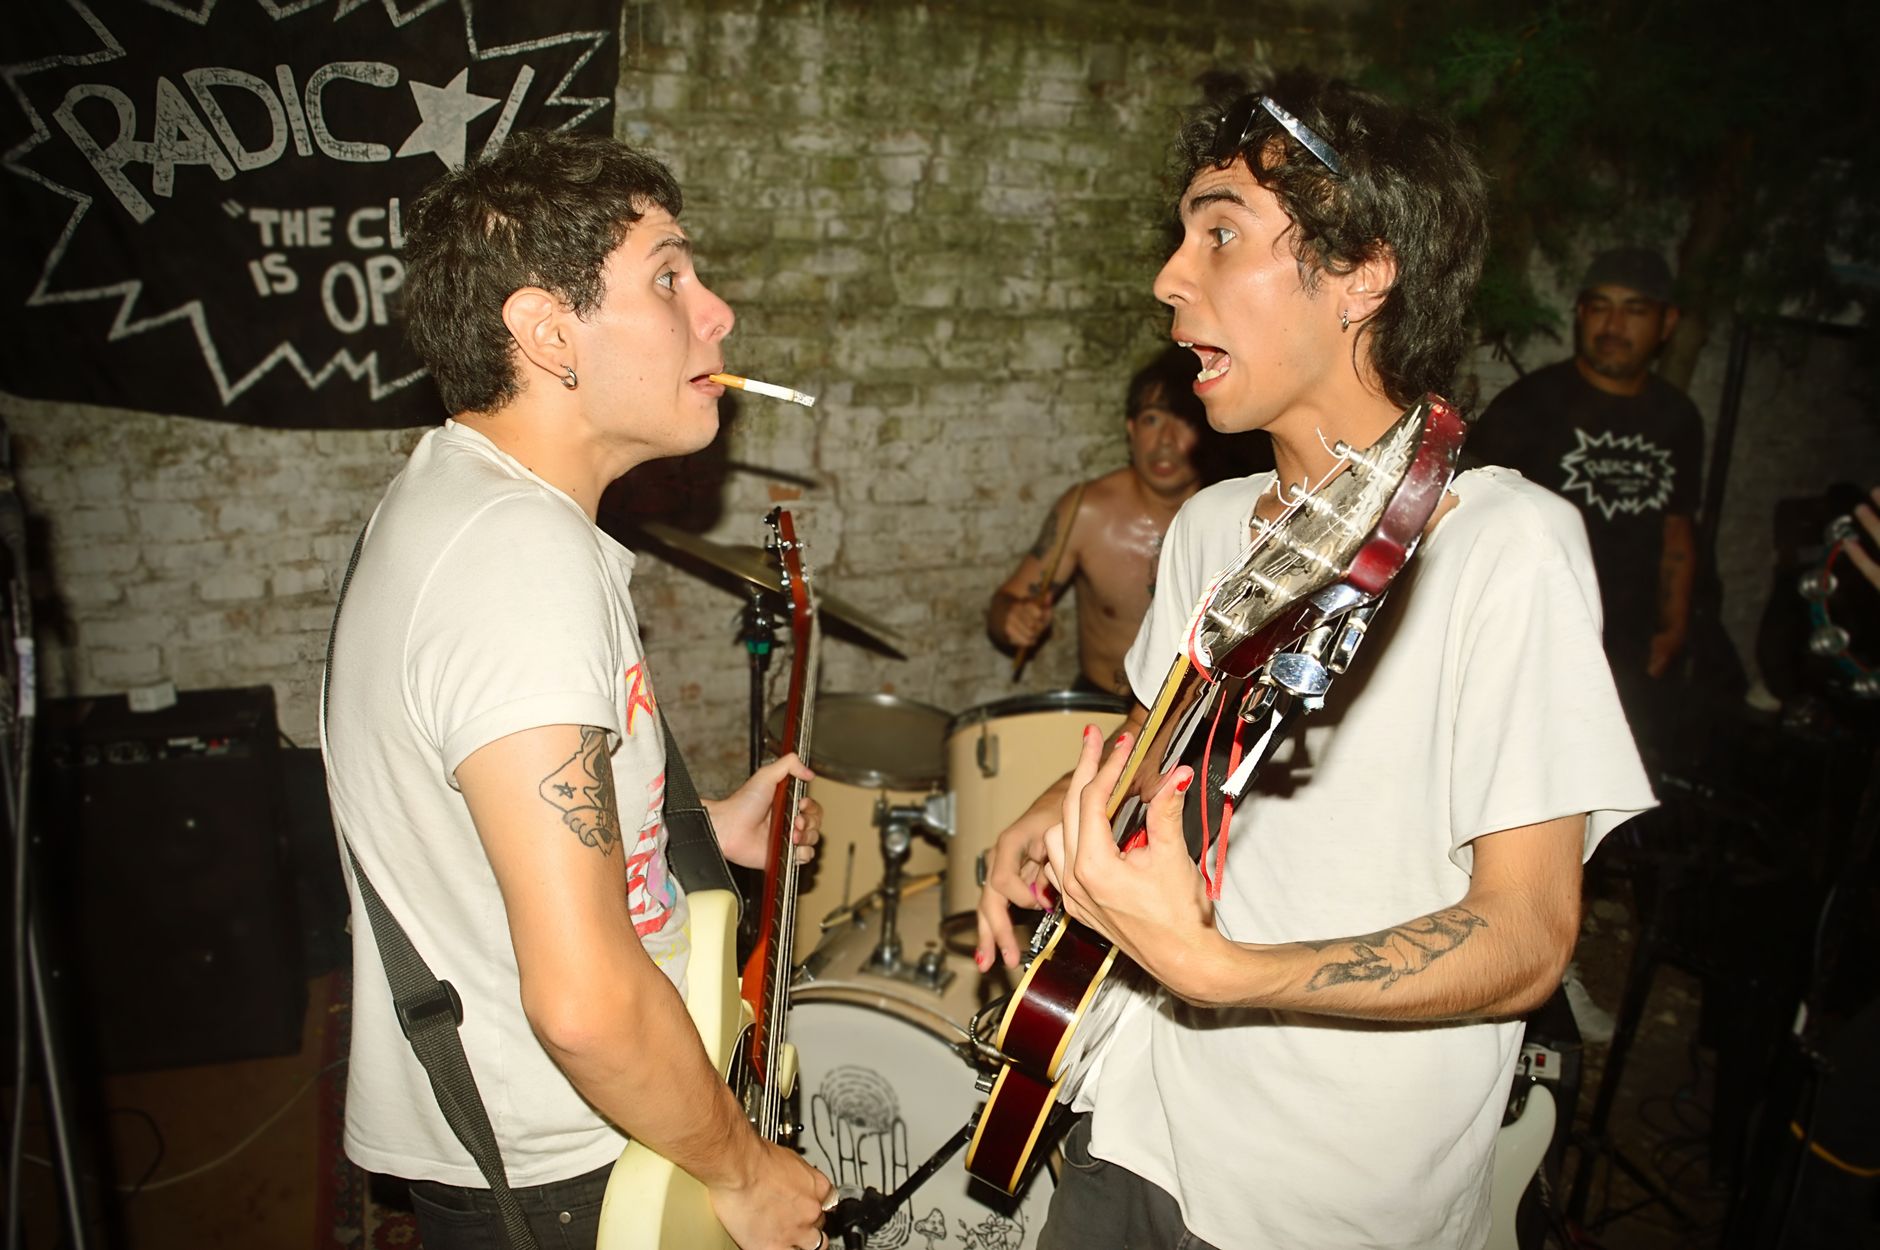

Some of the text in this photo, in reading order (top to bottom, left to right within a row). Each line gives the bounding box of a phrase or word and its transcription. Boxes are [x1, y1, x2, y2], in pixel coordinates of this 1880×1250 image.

[348, 197, 406, 249] CL
[249, 253, 405, 334] IS OP
